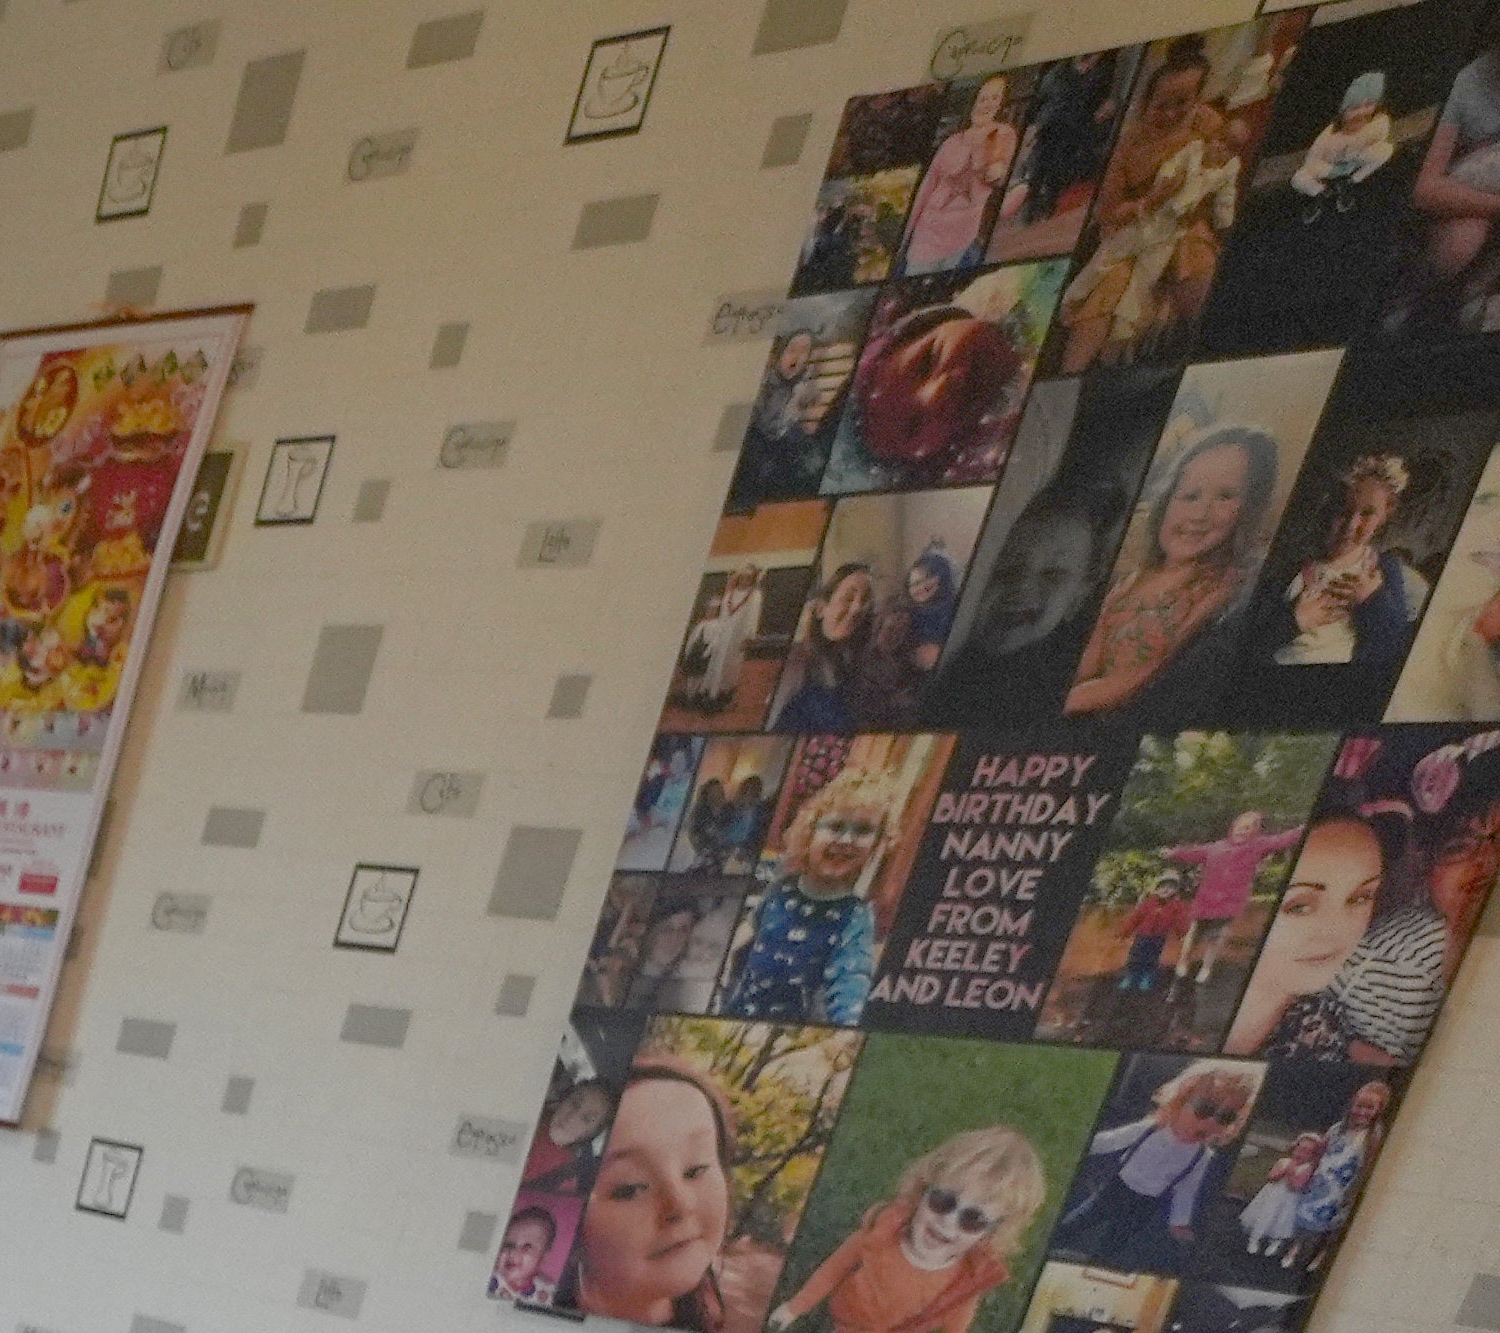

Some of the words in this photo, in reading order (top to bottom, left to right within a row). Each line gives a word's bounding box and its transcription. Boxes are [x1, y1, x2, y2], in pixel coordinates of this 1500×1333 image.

[972, 755, 1095, 787] HAPPY
[931, 793, 1110, 826] BIRTHDAY
[940, 831, 1074, 862] NANNY
[943, 867, 1044, 900] LOVE
[927, 904, 1034, 936] FROM
[903, 938, 1031, 973] KEELEY
[868, 975, 941, 1004] AND
[943, 977, 1044, 1011] LEON
